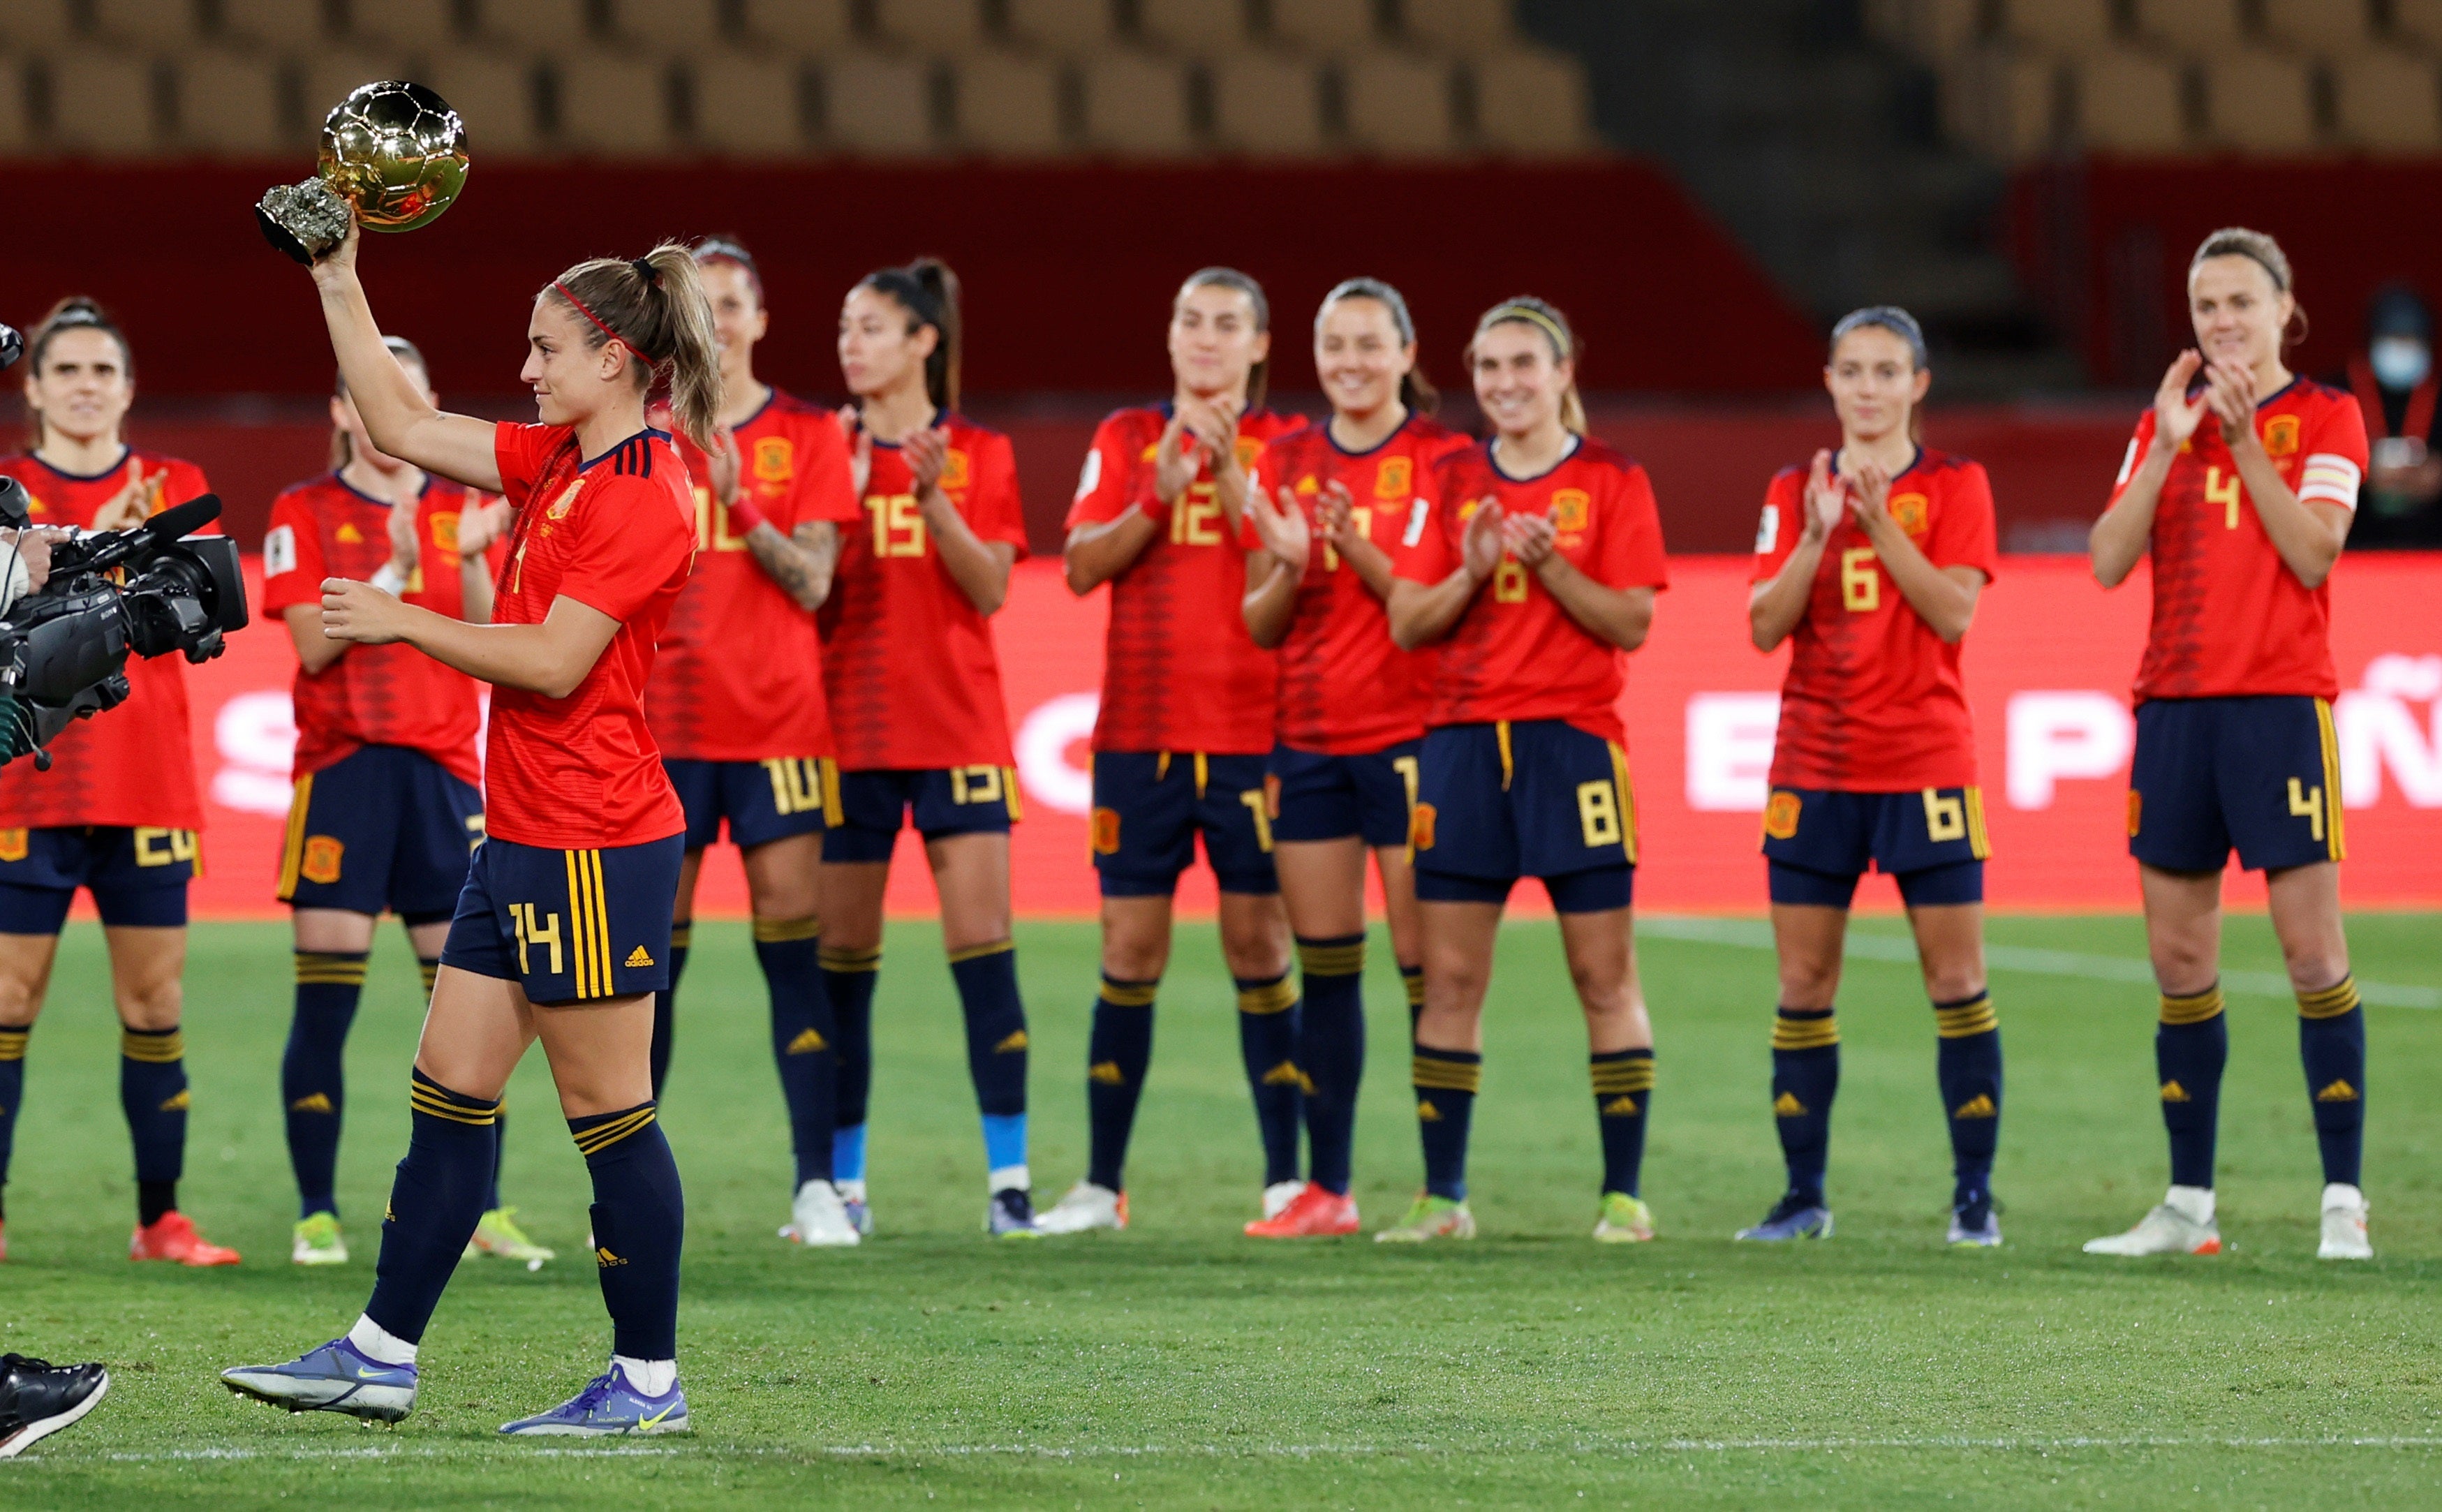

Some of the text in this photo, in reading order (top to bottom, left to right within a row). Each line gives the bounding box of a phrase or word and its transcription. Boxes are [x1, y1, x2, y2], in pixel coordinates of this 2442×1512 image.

[864, 495, 926, 558] 15
[1171, 483, 1222, 545] 12
[2204, 466, 2241, 529] 4
[1842, 547, 1879, 612] 6
[760, 756, 821, 815] 10
[1576, 779, 1622, 847] 8
[1922, 787, 1966, 842] 6
[2287, 776, 2323, 841] 4
[508, 903, 563, 974] 14
[625, 958, 654, 968] adidas
